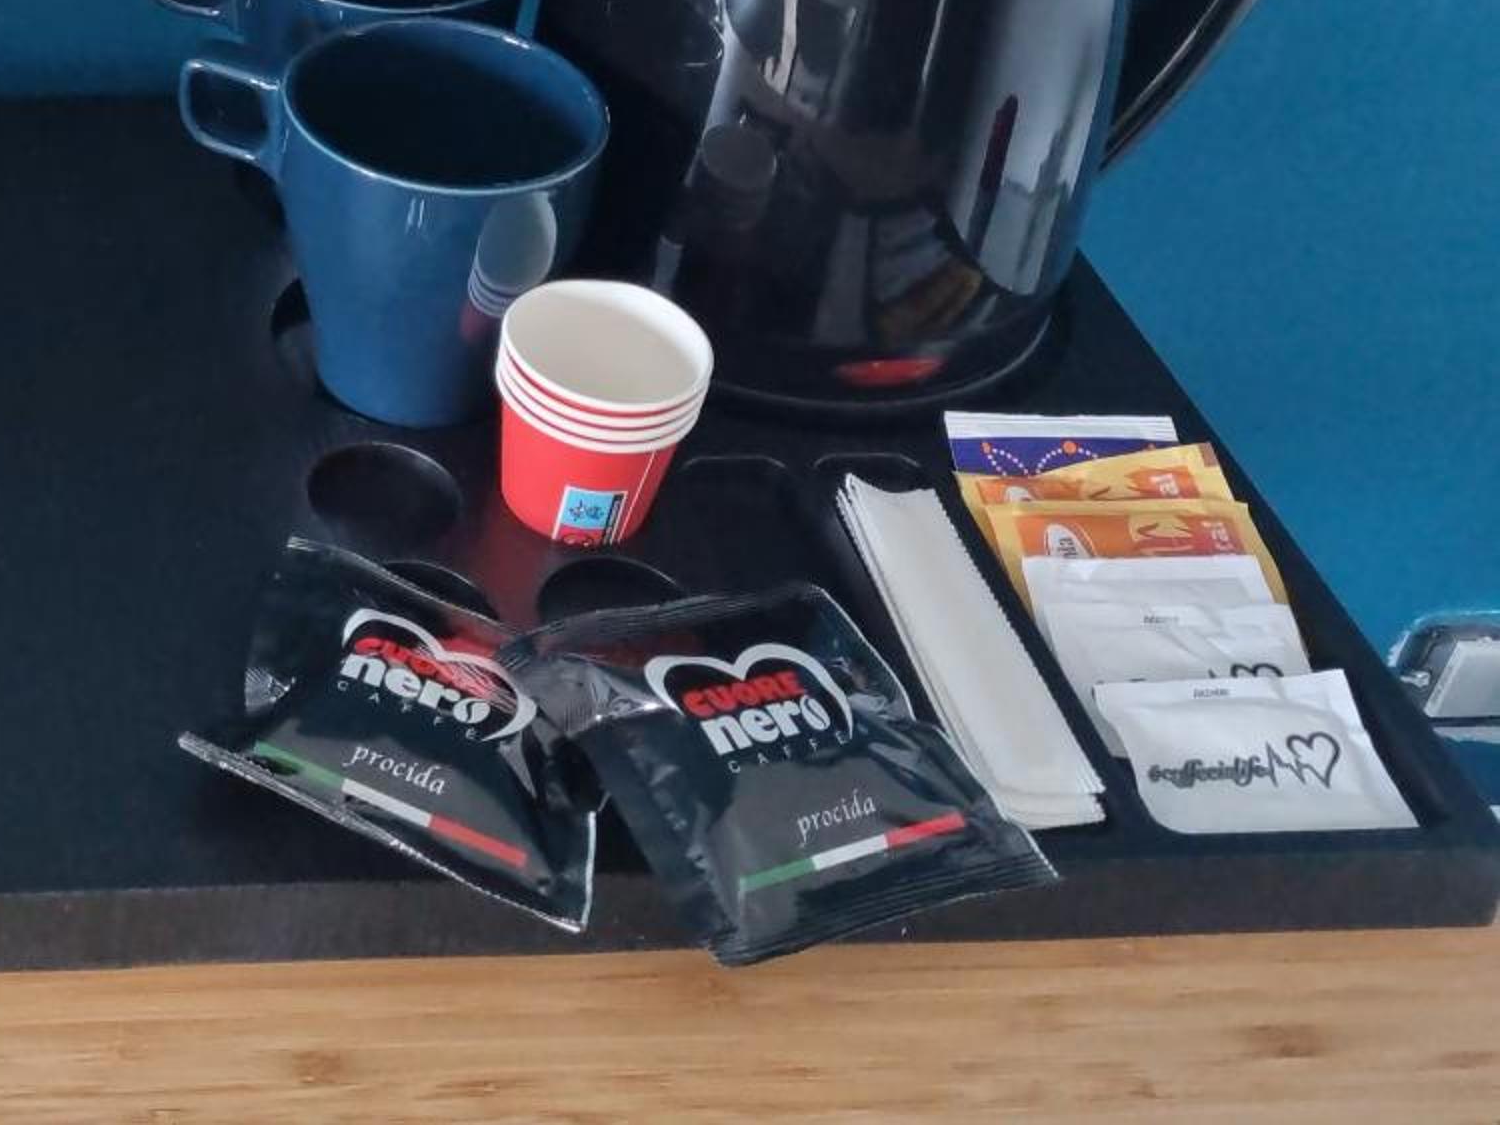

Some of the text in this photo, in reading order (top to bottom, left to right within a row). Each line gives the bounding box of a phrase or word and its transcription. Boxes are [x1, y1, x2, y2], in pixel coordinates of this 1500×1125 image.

[339, 652, 491, 725] nero
[682, 670, 806, 718] CUORE
[700, 694, 832, 757] nero
[341, 745, 446, 796] procida
[797, 787, 877, 849] procida
